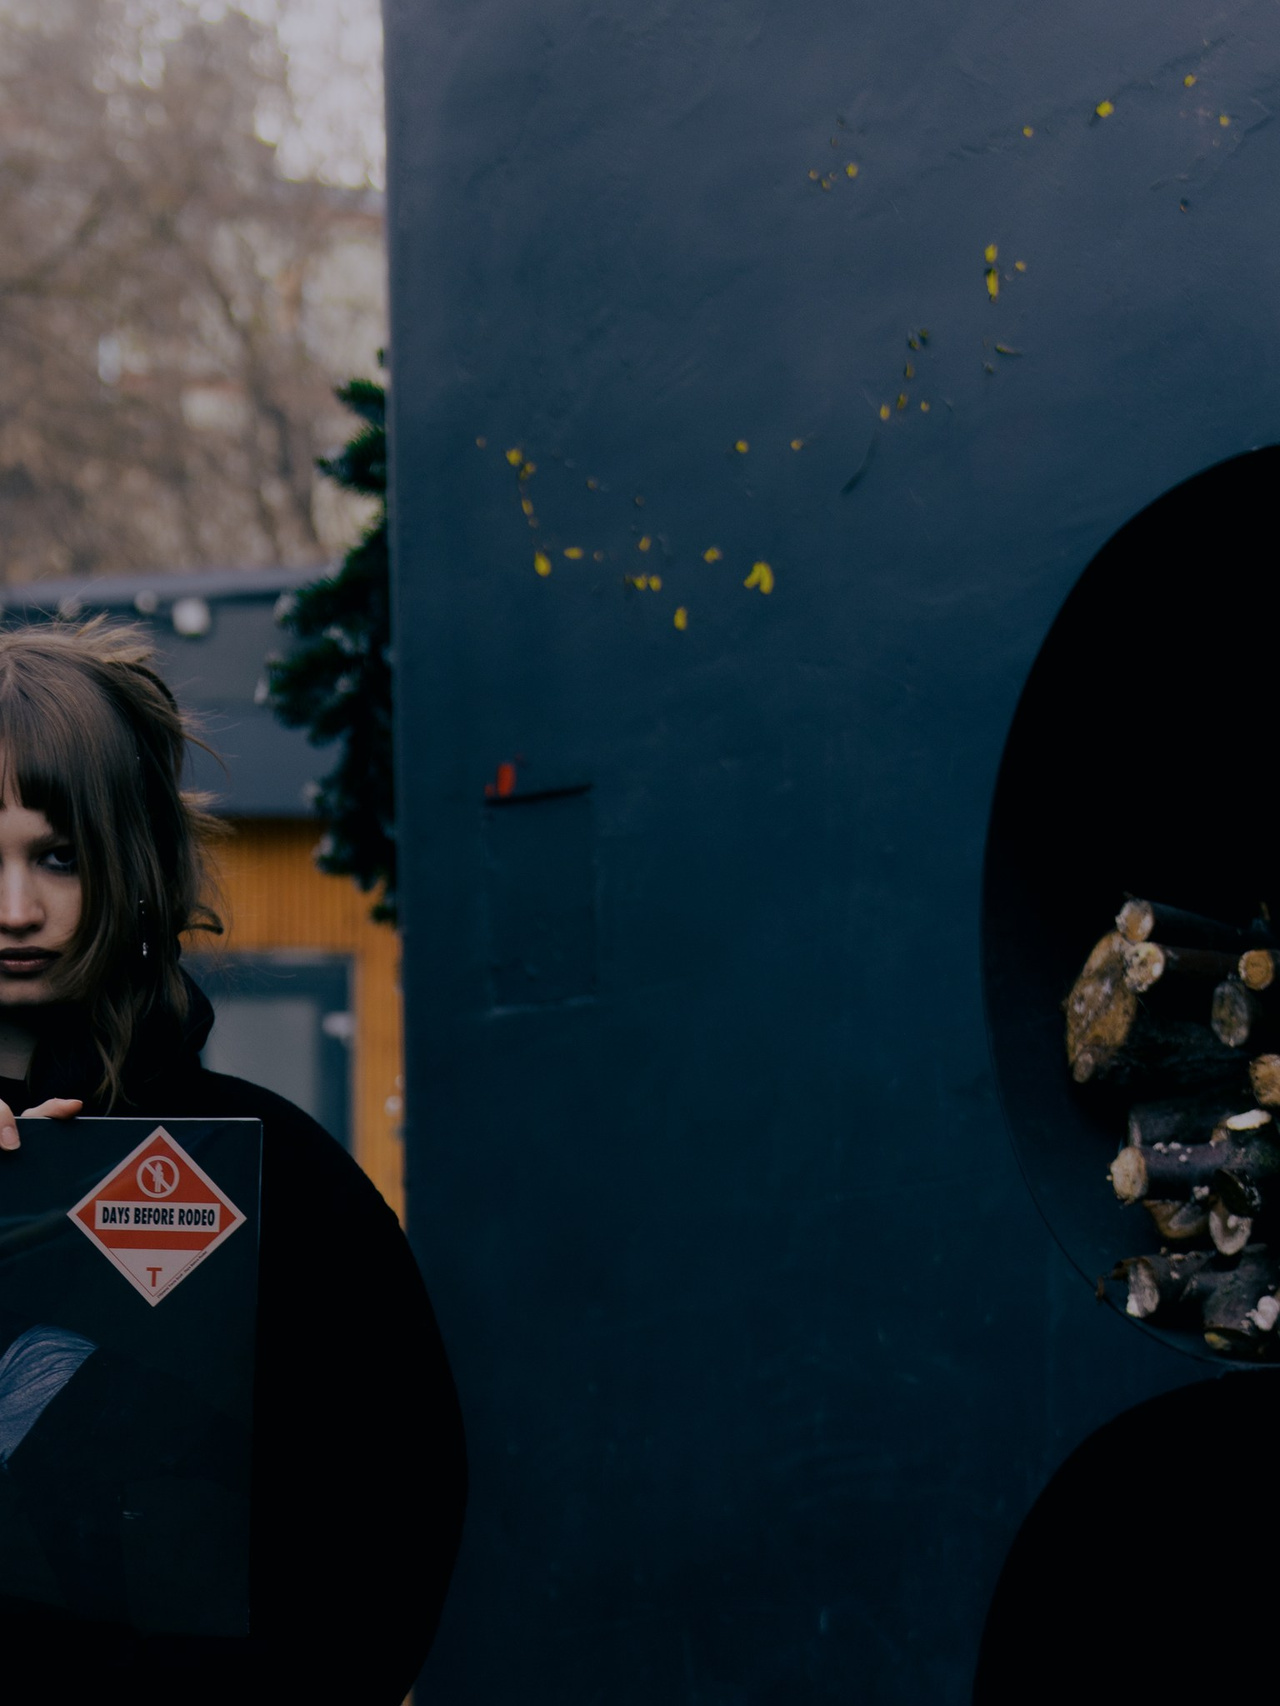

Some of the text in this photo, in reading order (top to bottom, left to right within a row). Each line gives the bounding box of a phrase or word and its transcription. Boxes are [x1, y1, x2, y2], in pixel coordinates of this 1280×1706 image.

[102, 1206, 216, 1226] DAYS BEFORE RODEO
[146, 1267, 162, 1288] T
